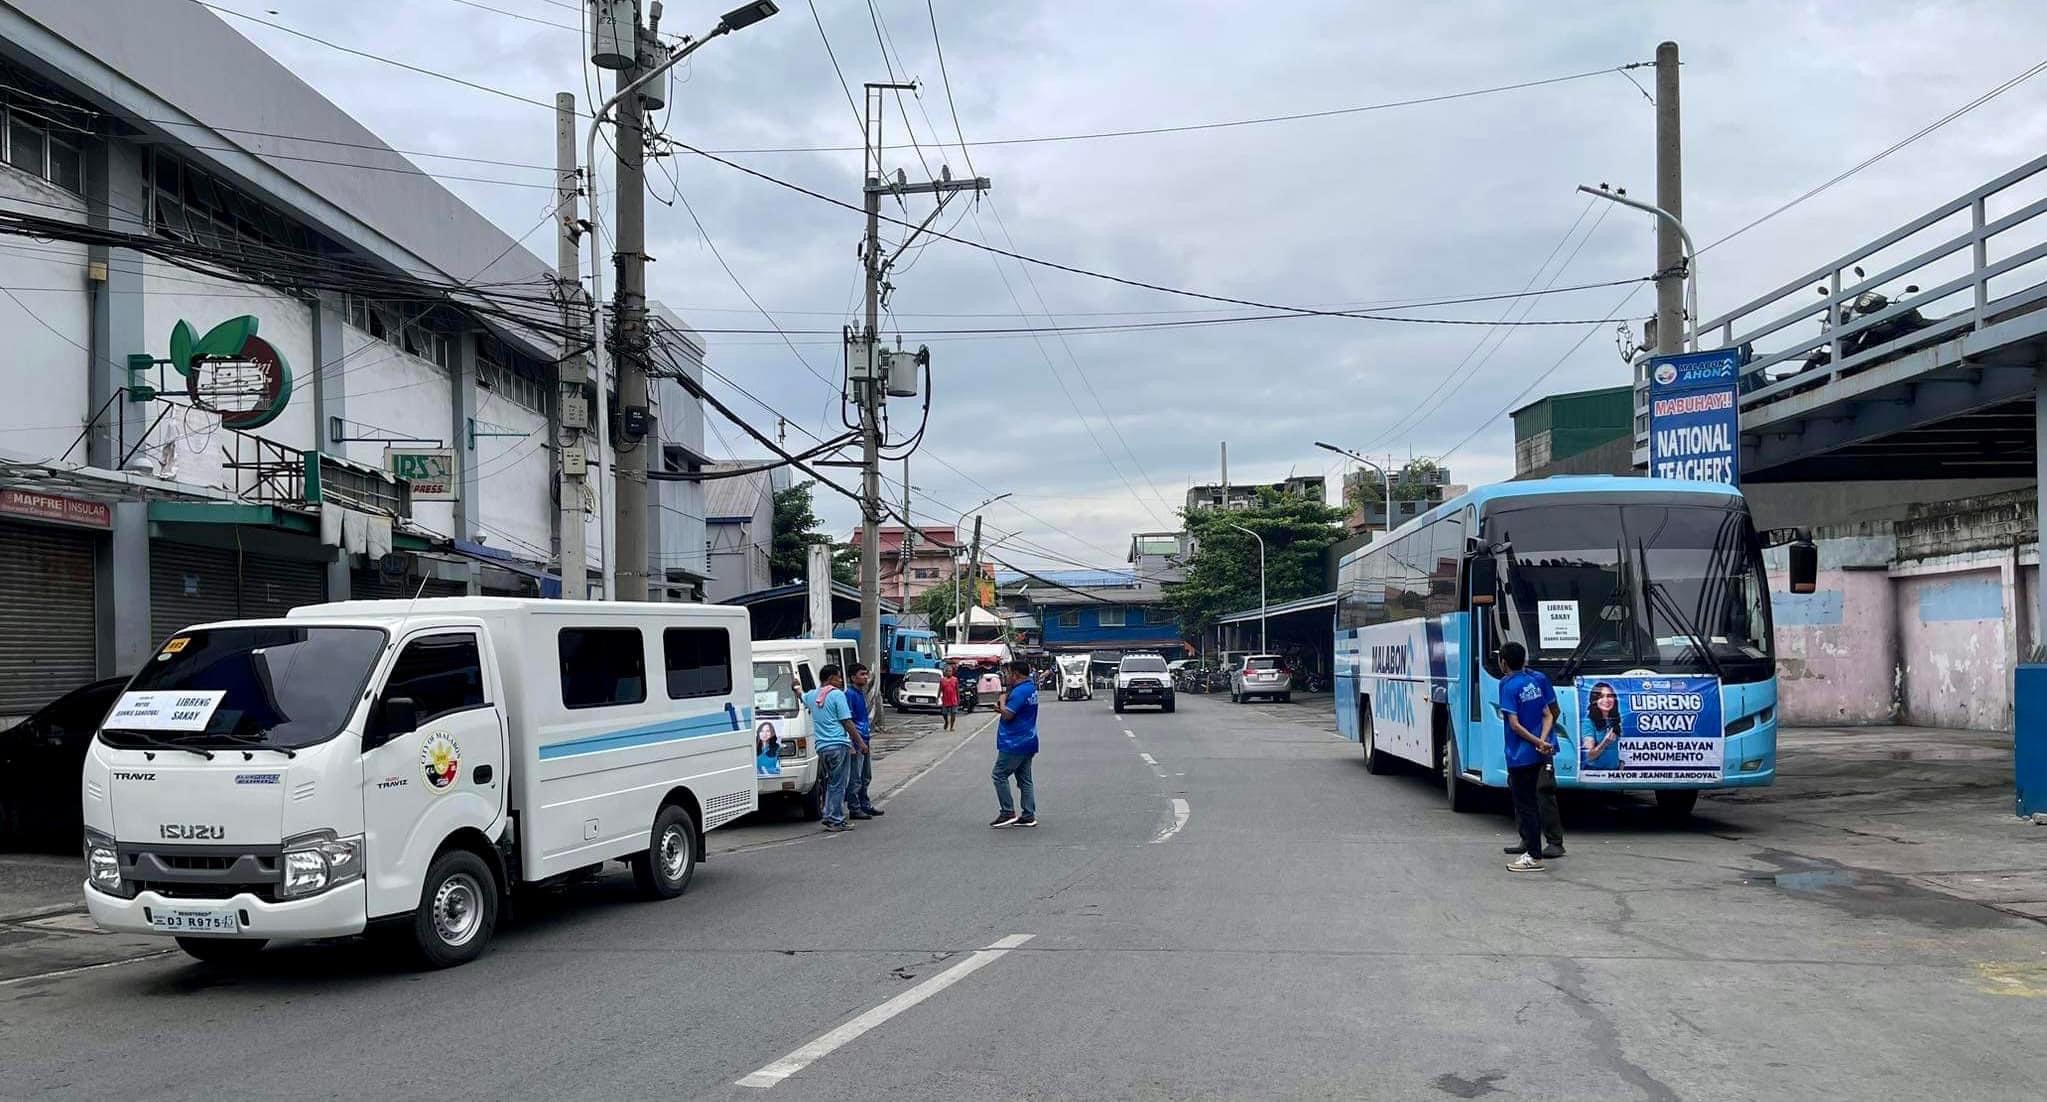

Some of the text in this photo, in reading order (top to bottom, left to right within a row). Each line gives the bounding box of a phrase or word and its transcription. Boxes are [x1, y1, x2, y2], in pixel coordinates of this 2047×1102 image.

[1680, 360, 1724, 372] MALABON
[1683, 368, 1720, 380] AHON
[1655, 391, 1732, 416] MABUHAY!!
[1657, 423, 1732, 458] NATIONAL
[1658, 456, 1732, 484] TEACHER'S
[13, 493, 62, 509] MAPFRE
[67, 500, 105, 516] INSULAR
[1372, 645, 1407, 675] MALABON
[175, 697, 211, 707] LIBRENG
[1376, 679, 1406, 723] AHON
[1631, 694, 1702, 711] LIBRENG
[171, 711, 200, 721] SAKAY
[1639, 714, 1696, 731] SAKAY
[1620, 741, 1713, 751] MALABON-BAYAN
[1629, 752, 1704, 761] -MONUMENTO
[114, 773, 156, 781] TRAVIZ
[376, 780, 408, 789] TRAVIZ
[160, 824, 225, 839] ISUZU
[167, 917, 182, 926] D3
[188, 917, 220, 928] R975
